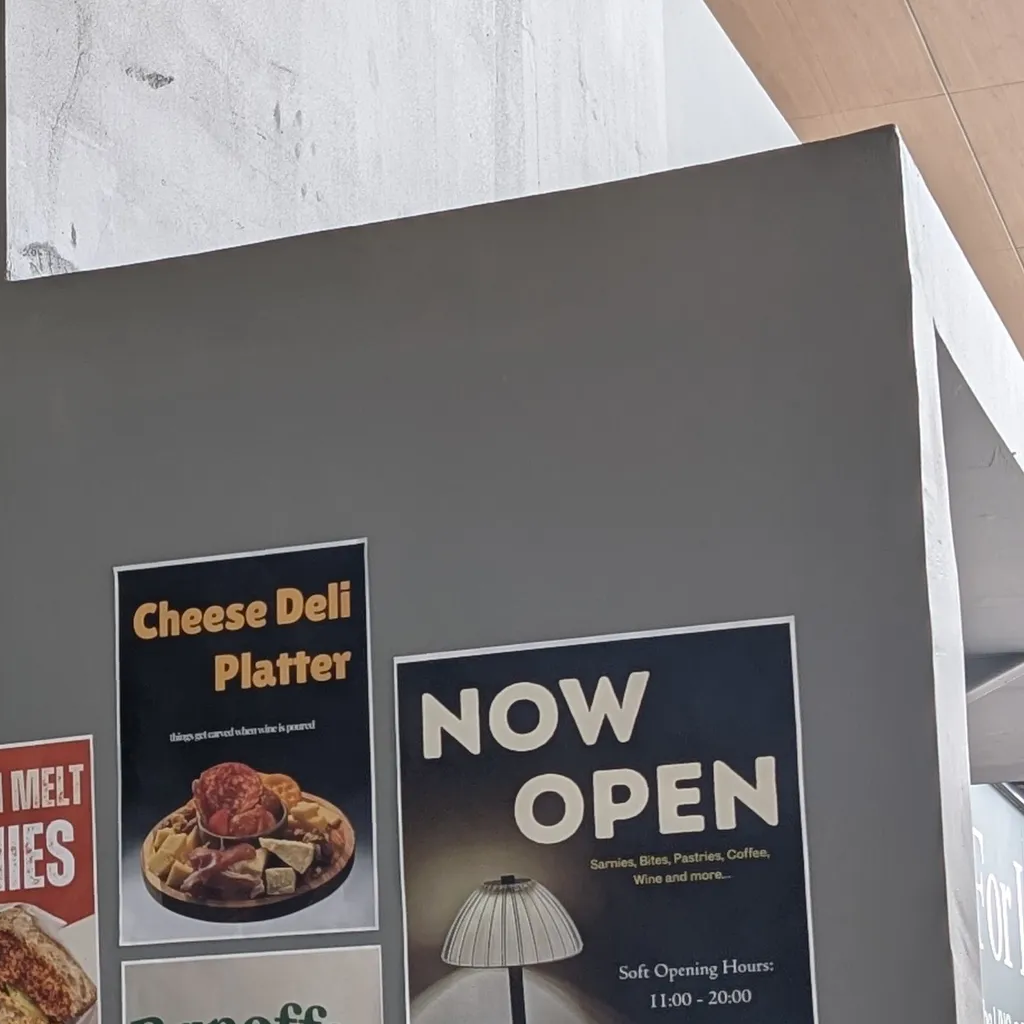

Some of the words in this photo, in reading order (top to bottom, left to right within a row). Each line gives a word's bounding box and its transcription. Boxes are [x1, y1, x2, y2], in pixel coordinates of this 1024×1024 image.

[133, 600, 268, 640] Cheese
[276, 580, 351, 625] Deli
[214, 651, 352, 692] Platter
[421, 670, 650, 759] NOW
[169, 732, 194, 743] things
[194, 731, 207, 741] get
[208, 727, 234, 739] carved
[235, 726, 257, 736] when
[258, 724, 278, 734] wine
[278, 722, 286, 733] is
[286, 720, 316, 734] poured
[11, 764, 84, 811] MELT
[514, 756, 779, 844] OPEN
[590, 857, 637, 870] Sarnies,
[639, 855, 671, 867] Bites,
[674, 851, 724, 864] Pastries,
[727, 847, 771, 860] Coffee,
[633, 873, 662, 885] Wine
[665, 871, 688, 883] and
[619, 964, 650, 980] Soft
[654, 961, 718, 982] Opening
[722, 959, 774, 975] Hours:
[650, 992, 692, 1008] 11:00
[708, 989, 752, 1006] 20:00
